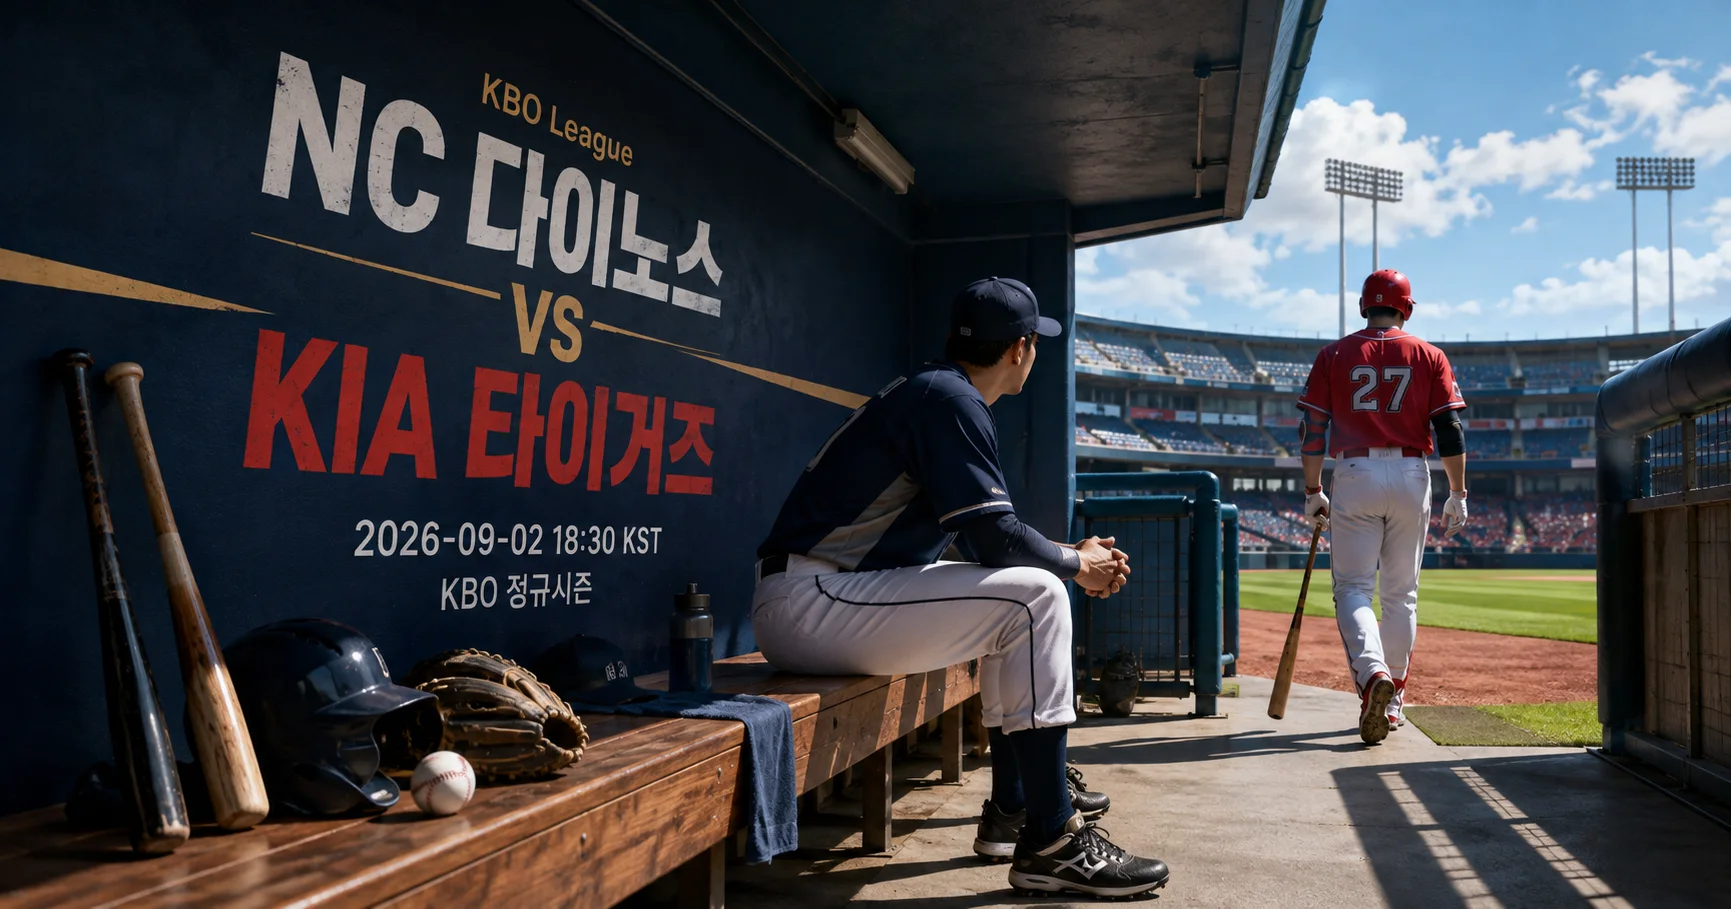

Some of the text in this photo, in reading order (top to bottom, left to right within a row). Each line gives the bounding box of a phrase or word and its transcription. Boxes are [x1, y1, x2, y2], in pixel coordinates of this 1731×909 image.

[481, 72, 633, 166] KBO League
[261, 50, 724, 318] NC 다이노스
[511, 281, 584, 363] VS
[242, 328, 716, 496] KIA 타이거즈
[1350, 364, 1413, 413] 27
[353, 519, 663, 557] 2026-09-02 18:30 KST
[440, 571, 593, 611] KBO 정규시즌
